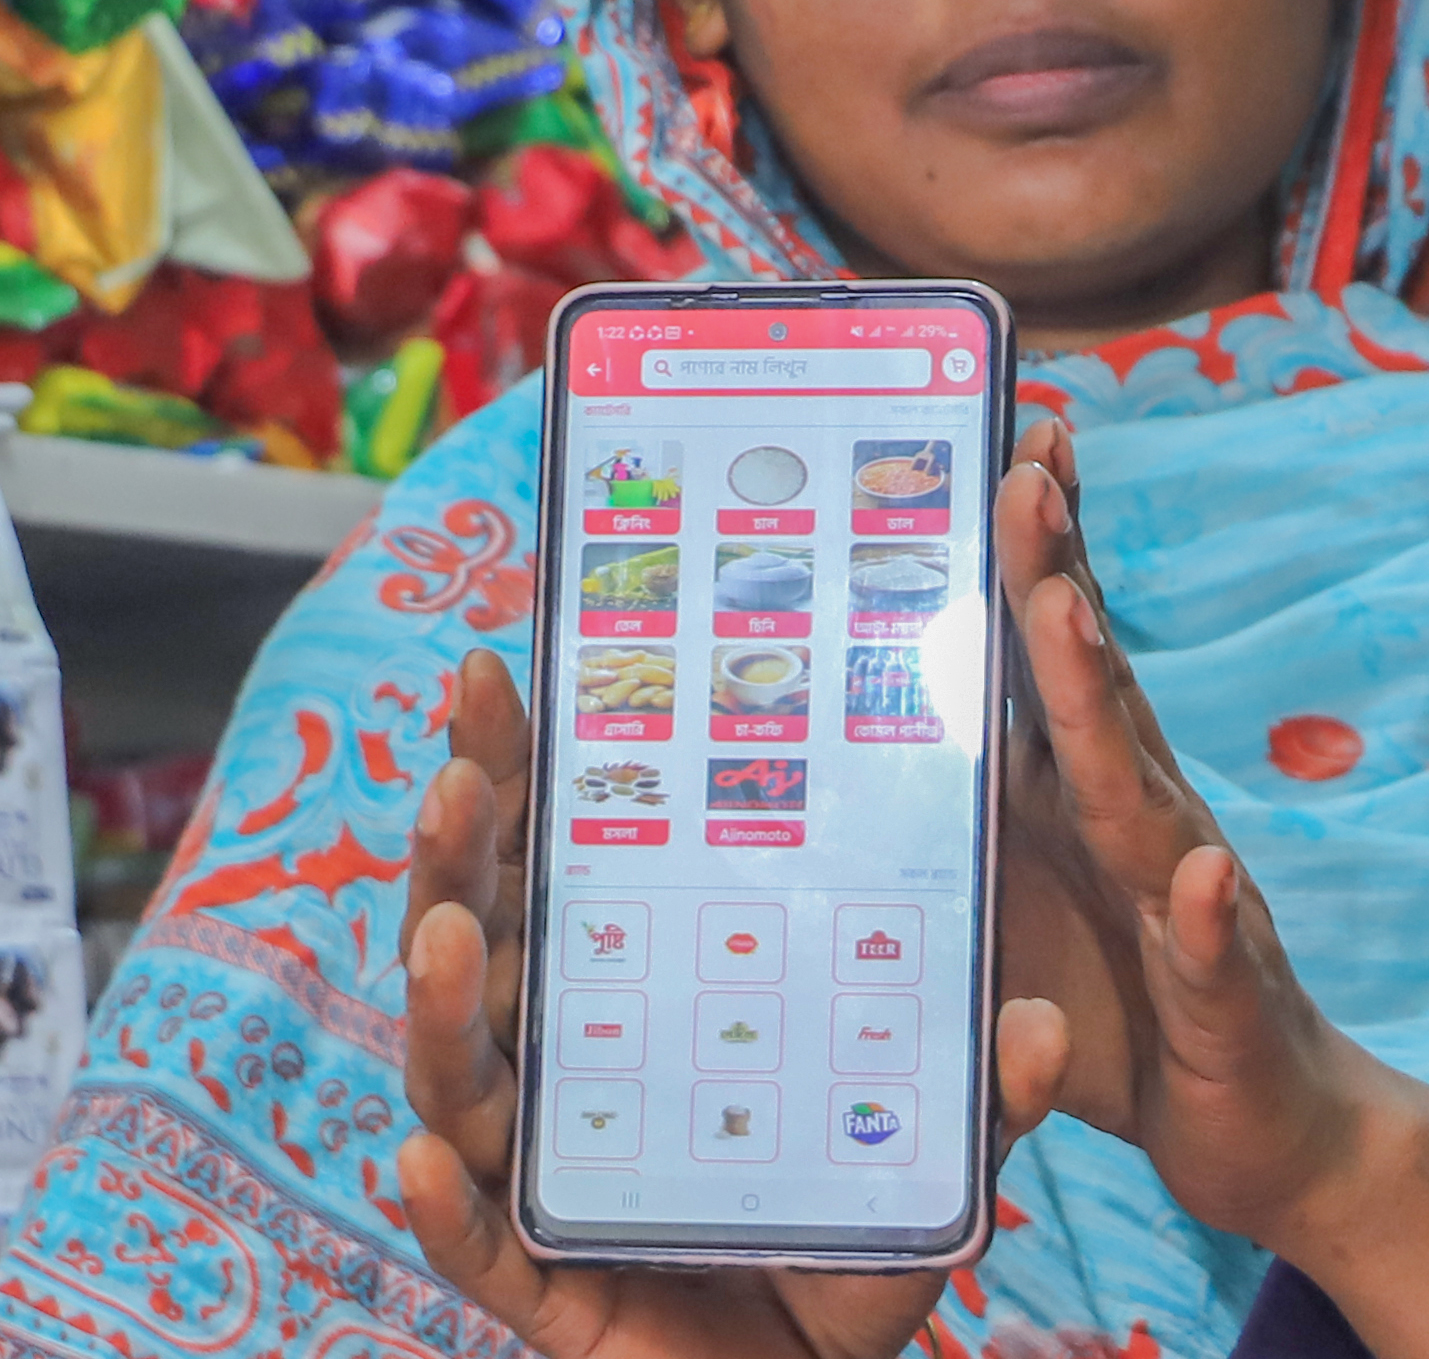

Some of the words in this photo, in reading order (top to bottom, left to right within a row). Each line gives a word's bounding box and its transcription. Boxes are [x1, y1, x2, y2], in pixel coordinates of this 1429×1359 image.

[596, 326, 626, 339] 1:22
[917, 325, 946, 338] 29%
[680, 358, 725, 375] পণ্যের
[731, 359, 759, 375] নাম
[762, 356, 808, 379] লিখুন
[612, 515, 651, 531] ক্লিনিং
[752, 516, 779, 531] চাল
[887, 516, 914, 531] ডাল
[614, 619, 642, 634] তেল
[748, 617, 776, 634] চিনি
[719, 826, 792, 844] Ajinomoto
